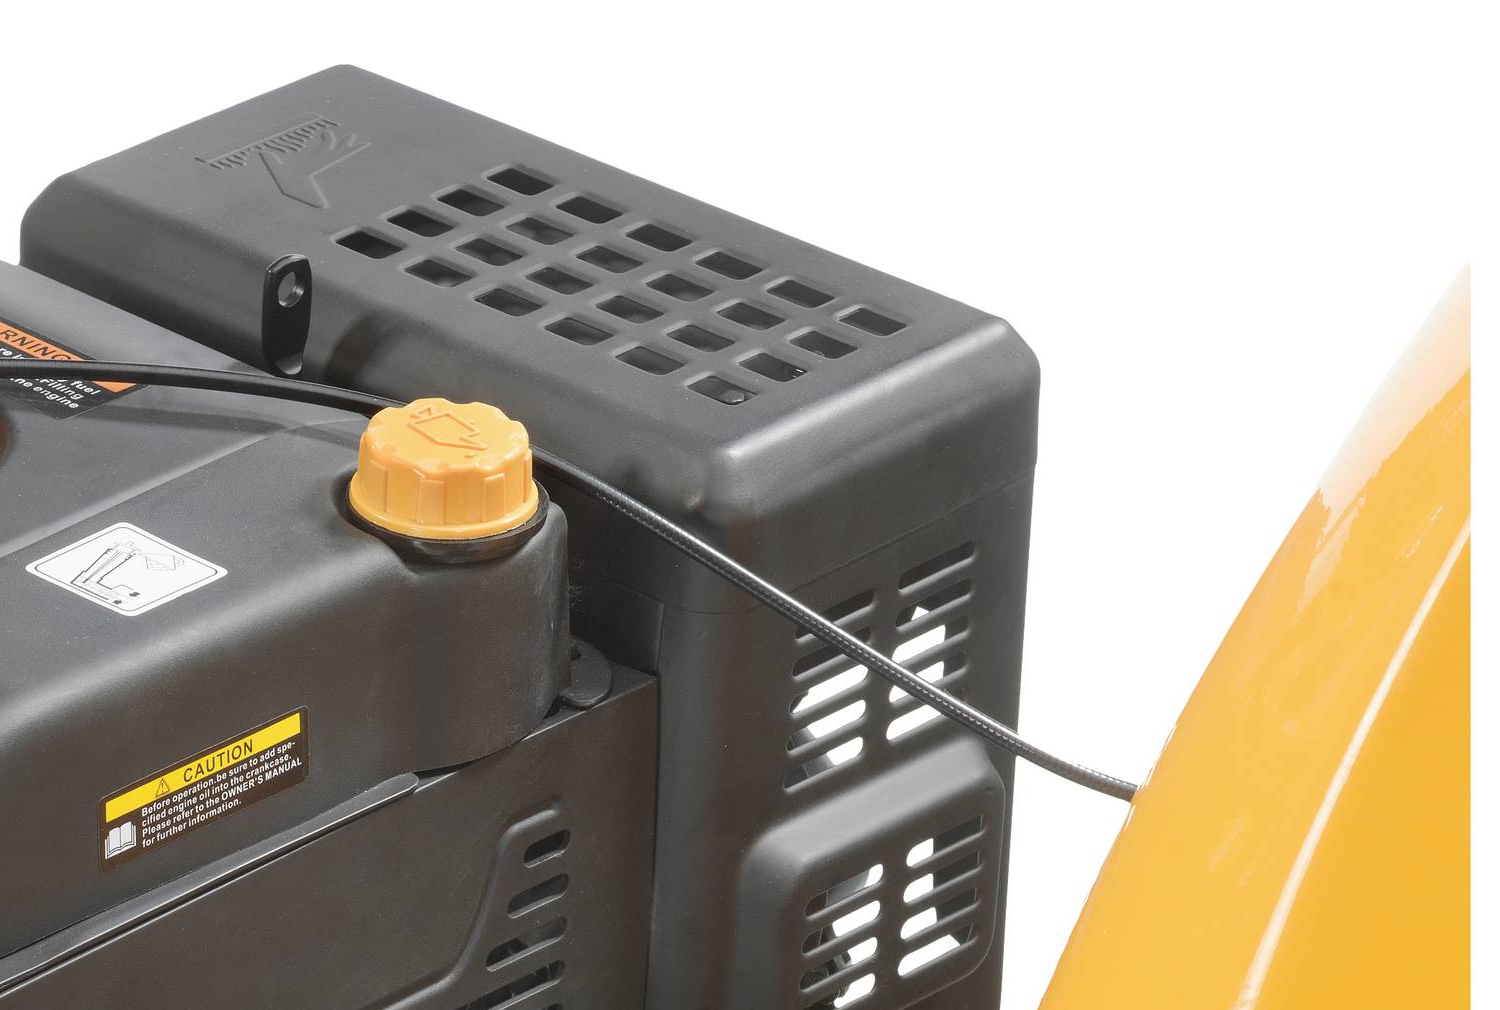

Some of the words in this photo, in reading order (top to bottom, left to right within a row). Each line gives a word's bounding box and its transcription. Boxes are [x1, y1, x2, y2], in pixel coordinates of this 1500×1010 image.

[33, 386, 79, 409] engine
[70, 380, 101, 395] fuel
[141, 798, 171, 817] Before
[228, 762, 248, 777] sure
[249, 758, 258, 767] to
[259, 747, 276, 762] add
[276, 741, 296, 756] spe-
[183, 739, 253, 783] CAUTION
[141, 808, 167, 827] cified
[168, 796, 198, 815] engine
[199, 789, 211, 801] oil
[211, 782, 229, 798] into
[230, 775, 244, 787] the
[245, 754, 292, 779] crankcase.
[142, 818, 172, 838] Please
[172, 808, 194, 824] refer
[195, 803, 205, 813] to
[205, 796, 220, 809] the
[221, 775, 264, 801] OWNER'S
[265, 757, 303, 782] MANUAL
[142, 835, 156, 848] for
[156, 822, 188, 841] further
[188, 799, 242, 827] information.
